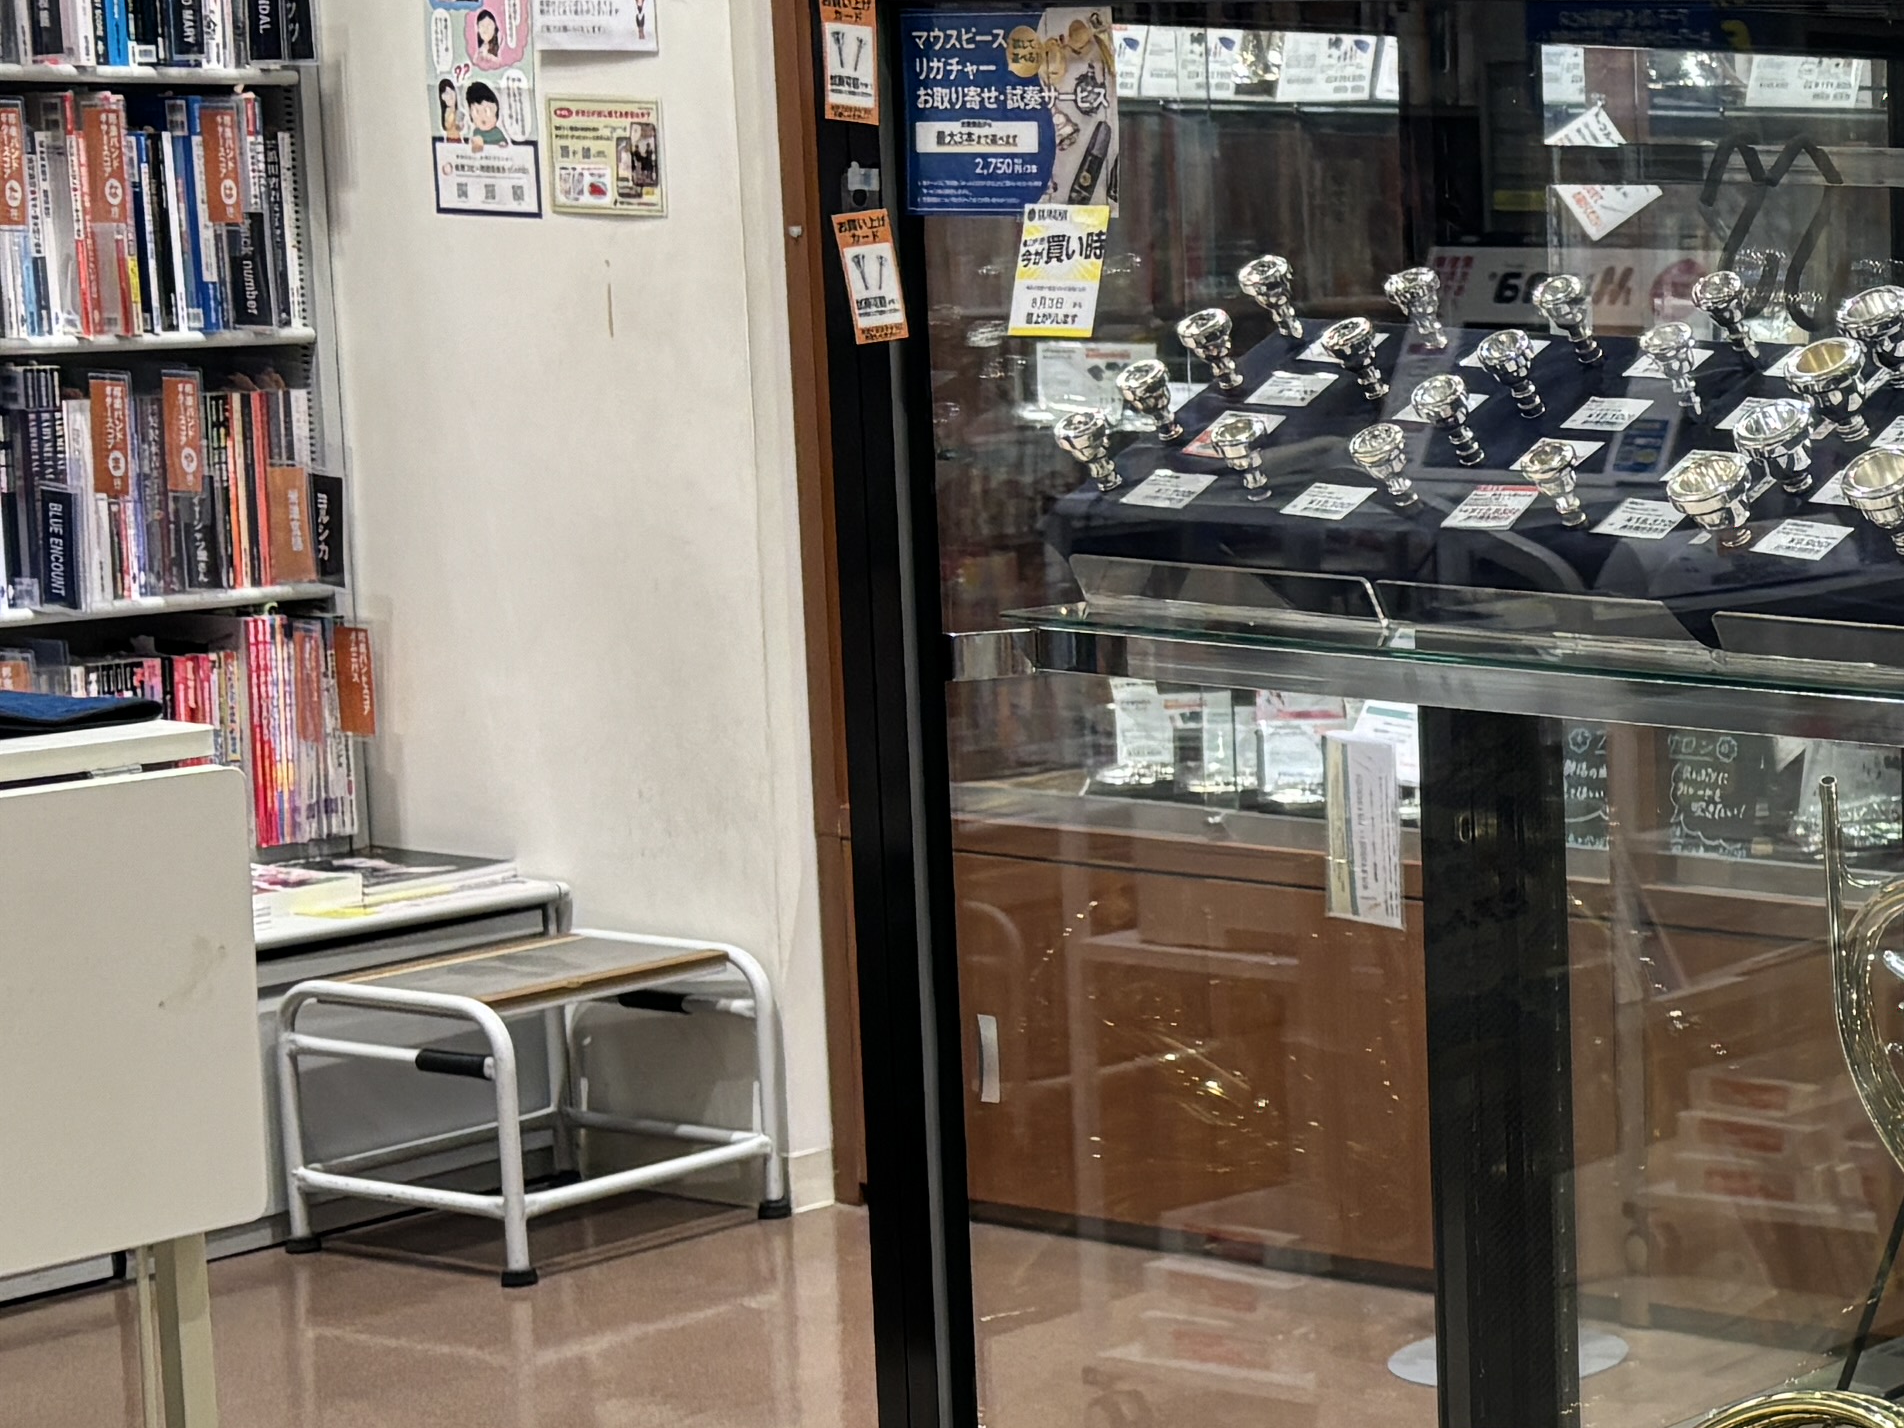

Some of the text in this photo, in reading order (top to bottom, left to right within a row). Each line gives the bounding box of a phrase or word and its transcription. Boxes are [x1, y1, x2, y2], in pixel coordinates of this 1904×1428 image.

[183, 8, 194, 44] MARY
[833, 10, 862, 22] カード
[911, 27, 1007, 50] マウスピース
[915, 59, 997, 80] リガチャー
[916, 86, 1109, 110] お取り寄せ・試奏サービス
[837, 216, 886, 234] お買い上げ
[851, 231, 880, 243] カード
[243, 260, 258, 315] number
[49, 502, 66, 597] BLUE ENCOUNT
